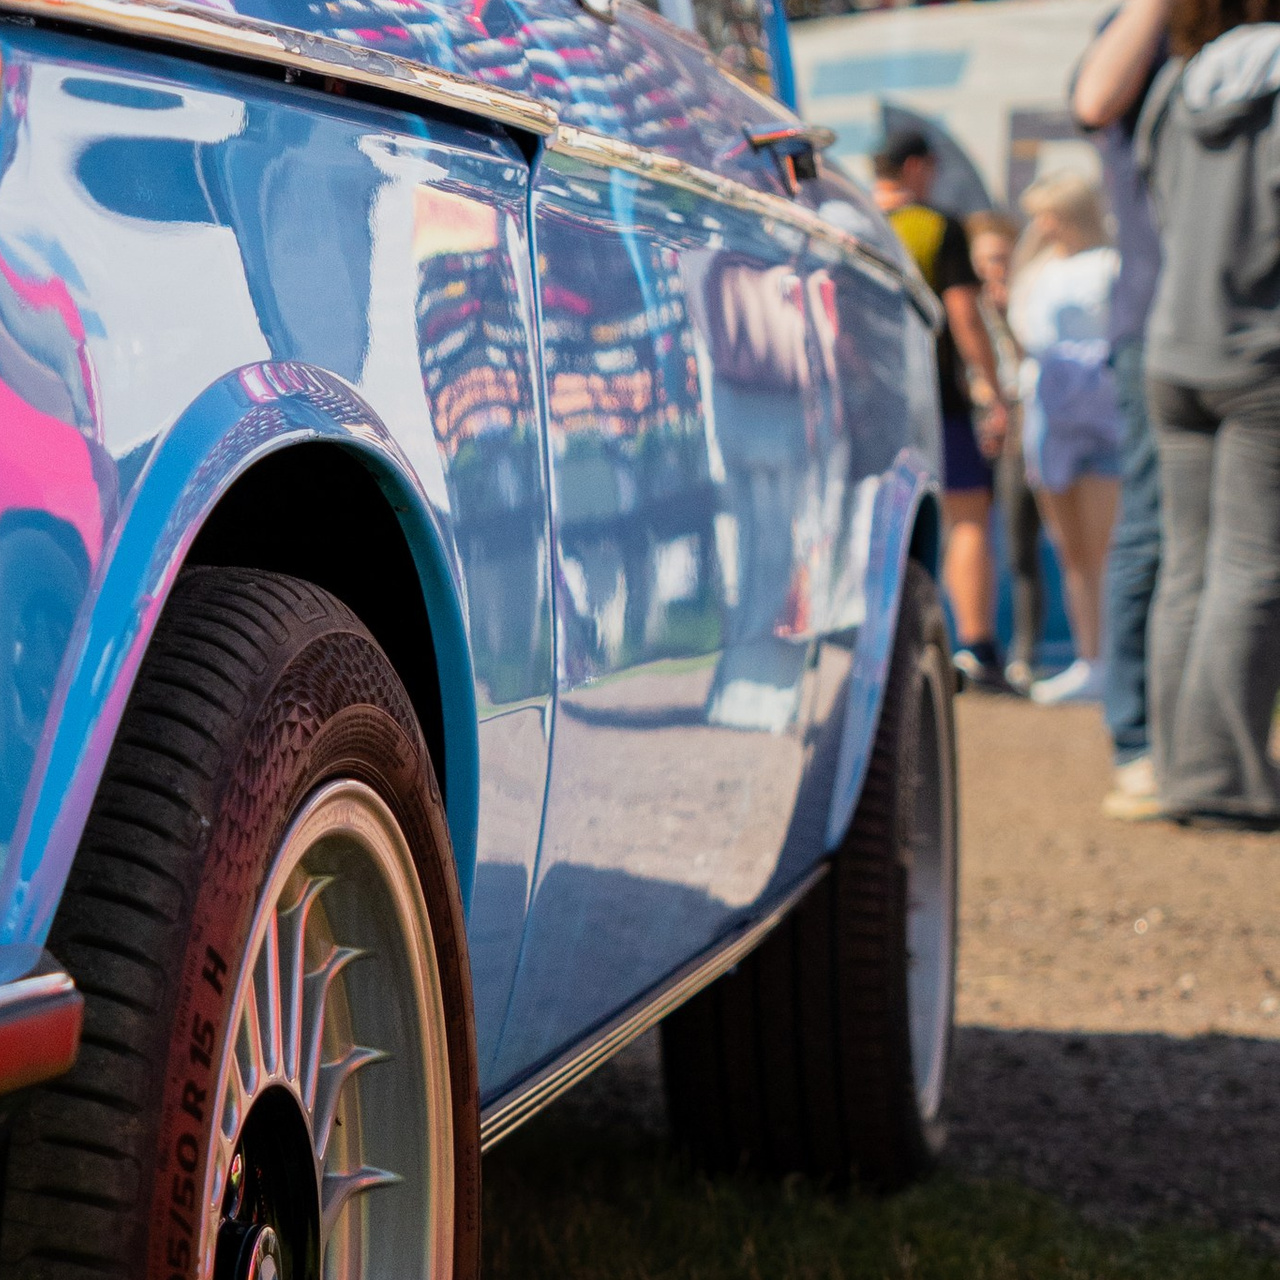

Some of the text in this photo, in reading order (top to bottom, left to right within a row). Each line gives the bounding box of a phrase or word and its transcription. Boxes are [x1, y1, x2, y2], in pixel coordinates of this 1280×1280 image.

[202, 945, 227, 995] H
[189, 1012, 215, 1070] 15
[181, 1080, 207, 1122] R
